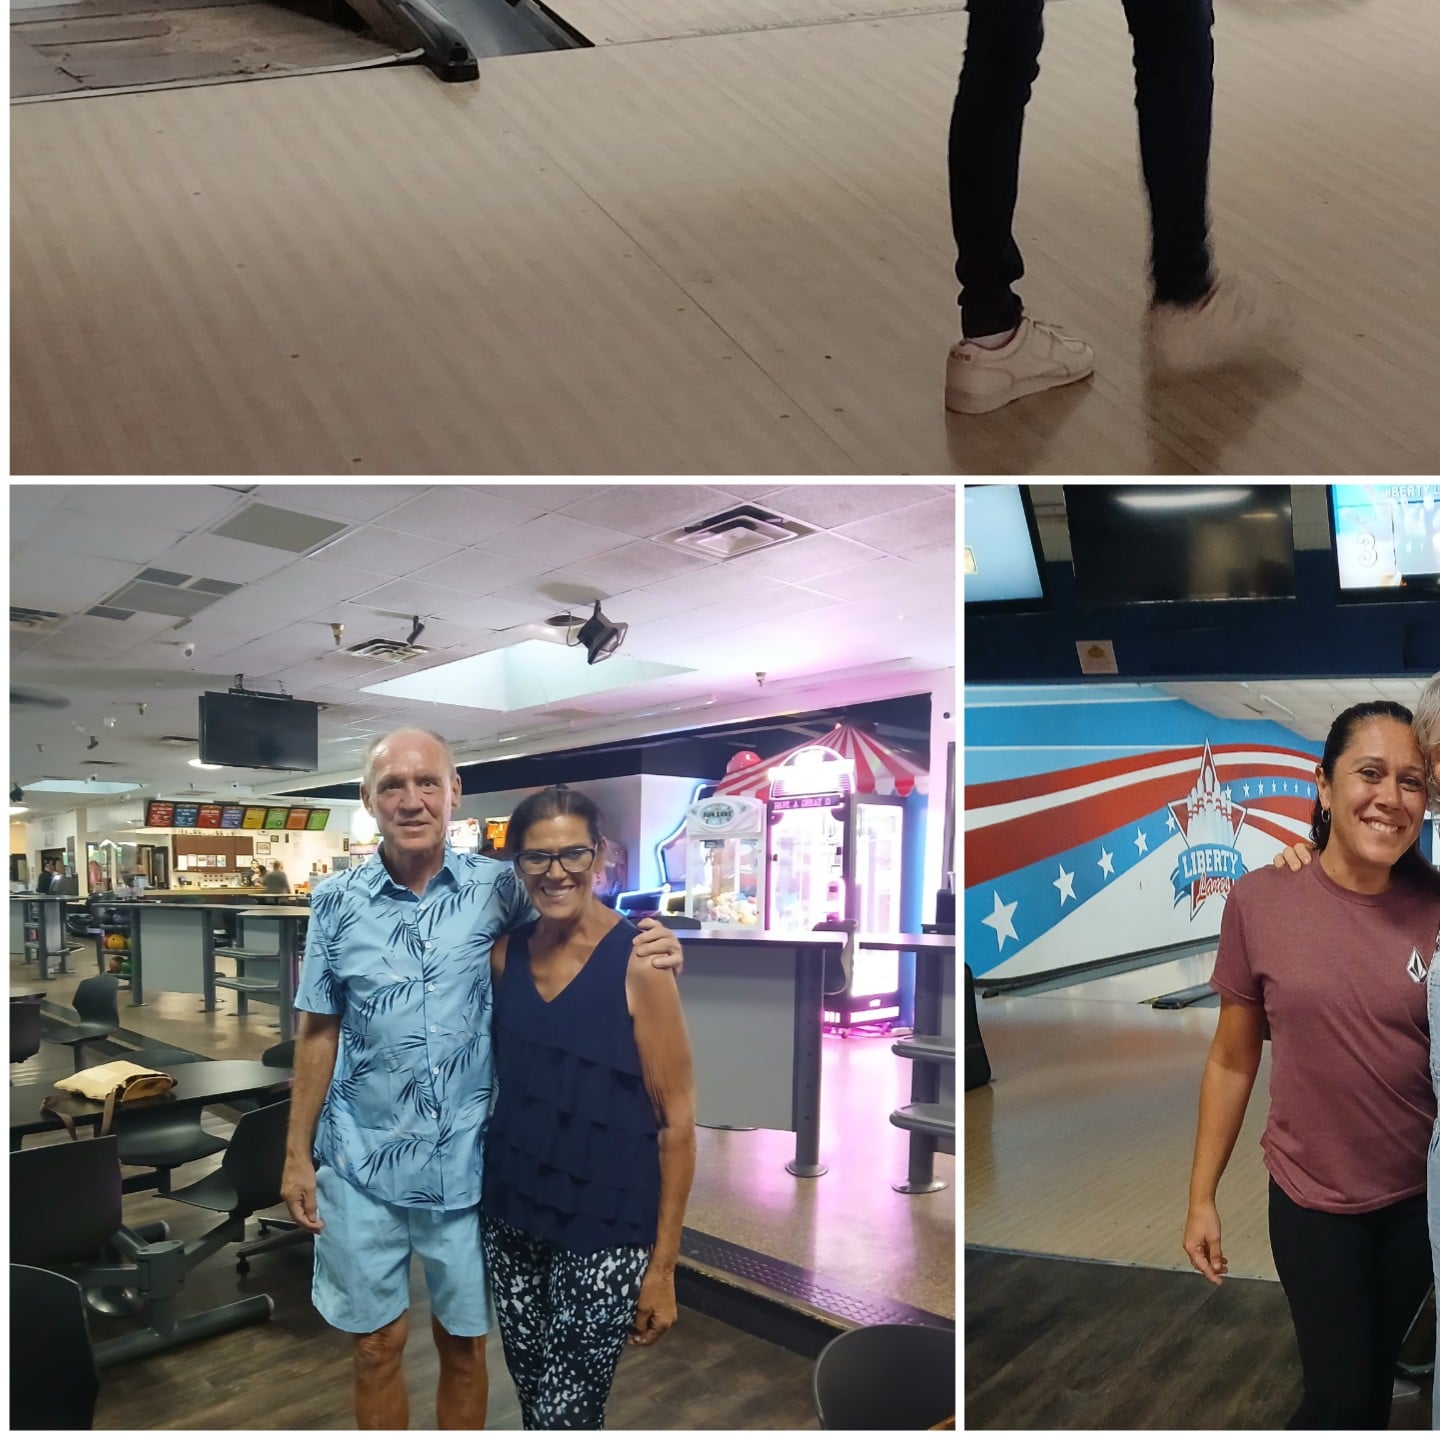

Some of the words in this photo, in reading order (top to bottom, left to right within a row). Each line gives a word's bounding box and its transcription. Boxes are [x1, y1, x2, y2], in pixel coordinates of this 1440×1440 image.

[1357, 532, 1378, 567] 3
[793, 800, 798, 808] A
[1182, 848, 1239, 879] LIBERTY
